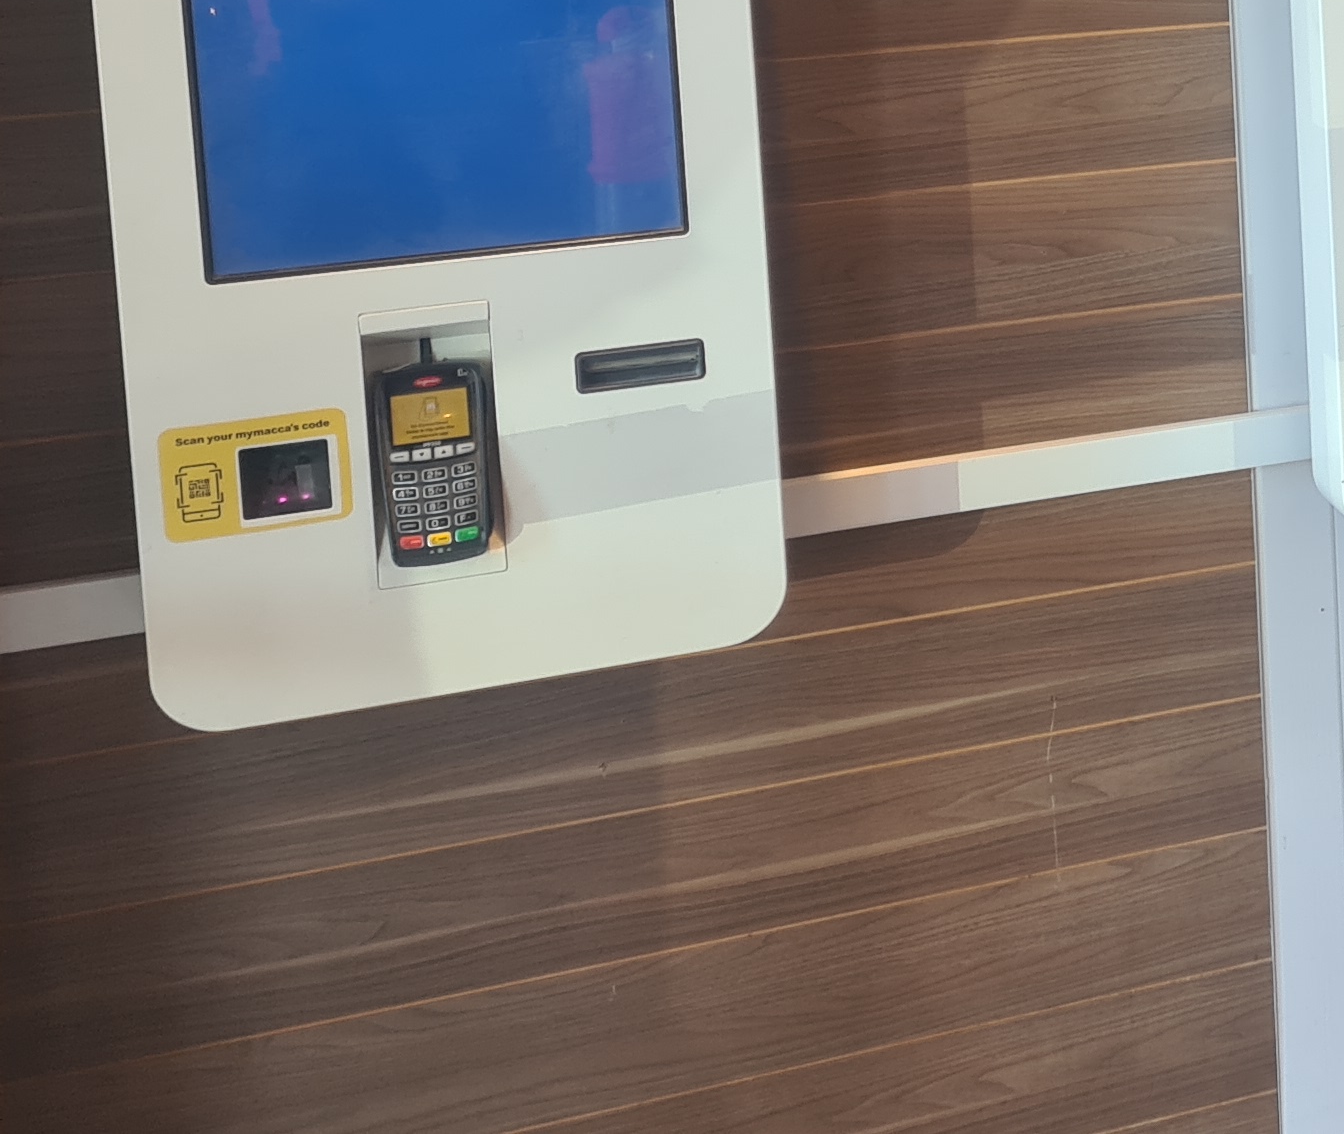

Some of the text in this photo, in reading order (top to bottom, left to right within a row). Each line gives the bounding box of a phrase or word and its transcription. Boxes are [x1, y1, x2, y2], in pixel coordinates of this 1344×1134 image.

[175, 419, 330, 447] Scan your mymacca's code
